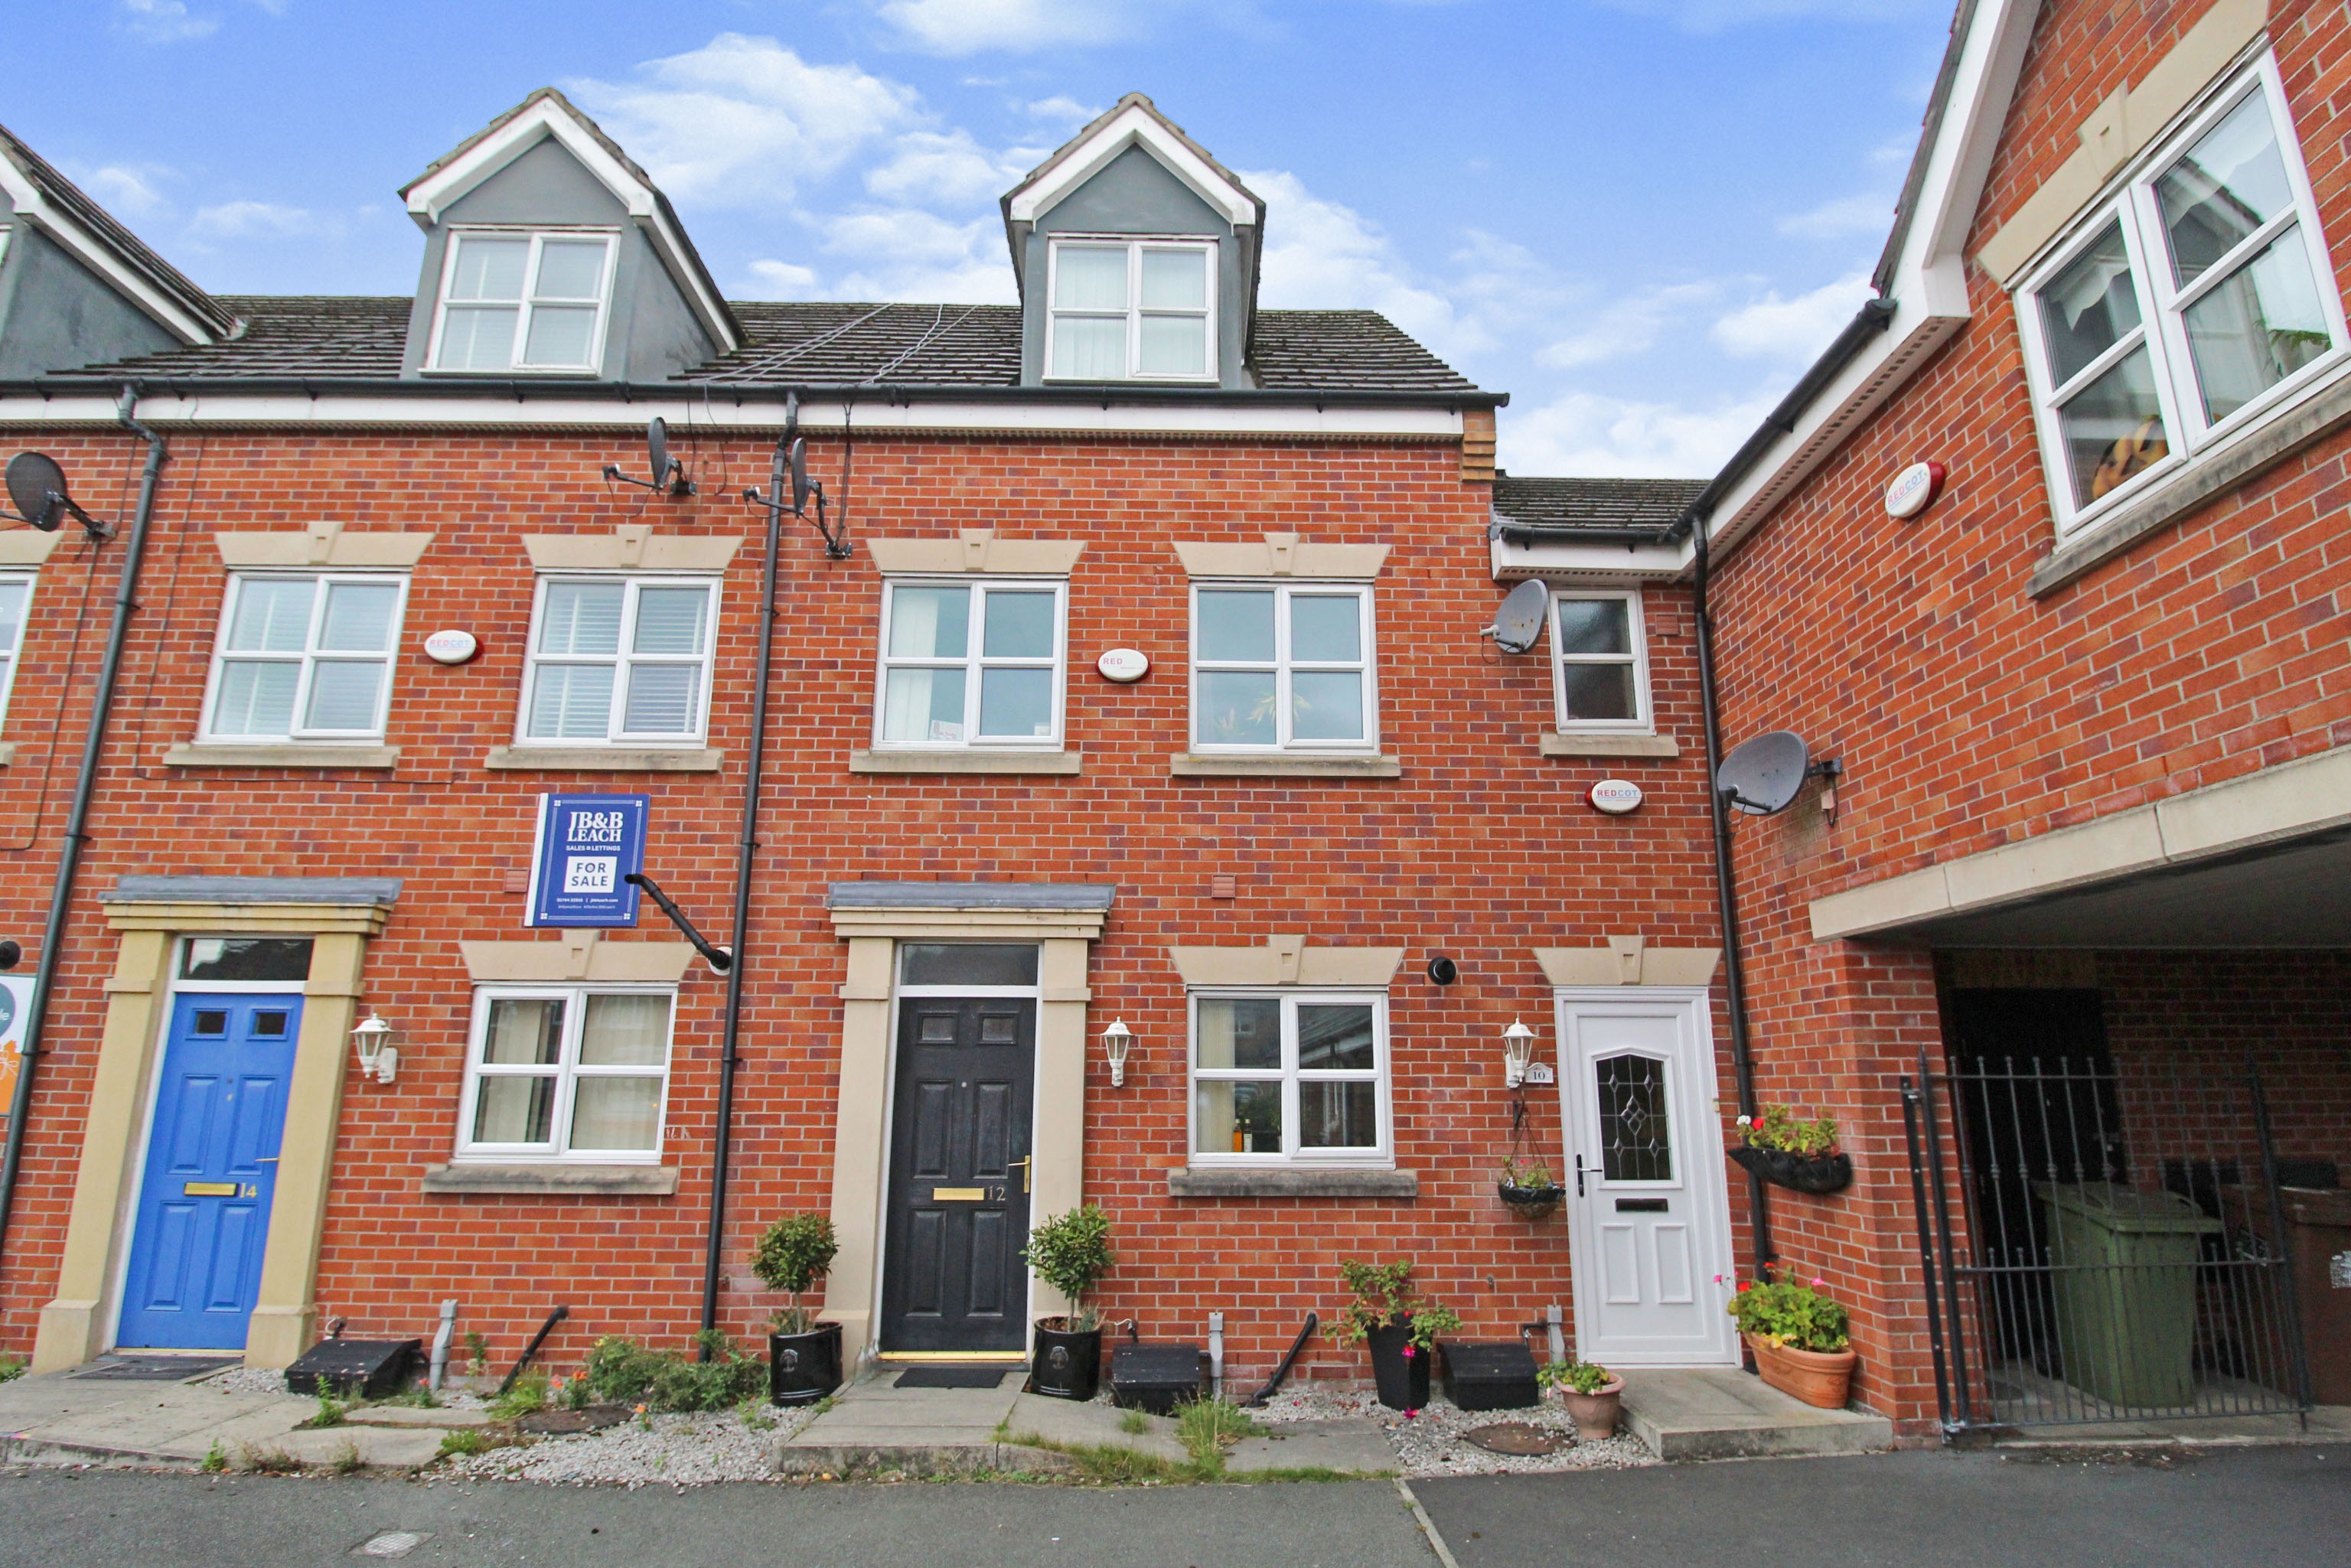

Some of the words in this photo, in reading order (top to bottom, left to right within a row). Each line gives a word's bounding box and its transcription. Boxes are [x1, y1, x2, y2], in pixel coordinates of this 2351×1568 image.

[1887, 468, 1923, 505] REDCOT
[569, 811, 624, 830] JB&B
[567, 829, 622, 843] LEACH
[576, 862, 607, 873] FOR
[571, 875, 608, 887] SALE
[1533, 1071, 1545, 1081] 10
[240, 1182, 257, 1198] 14
[988, 1185, 1006, 1201] 12
